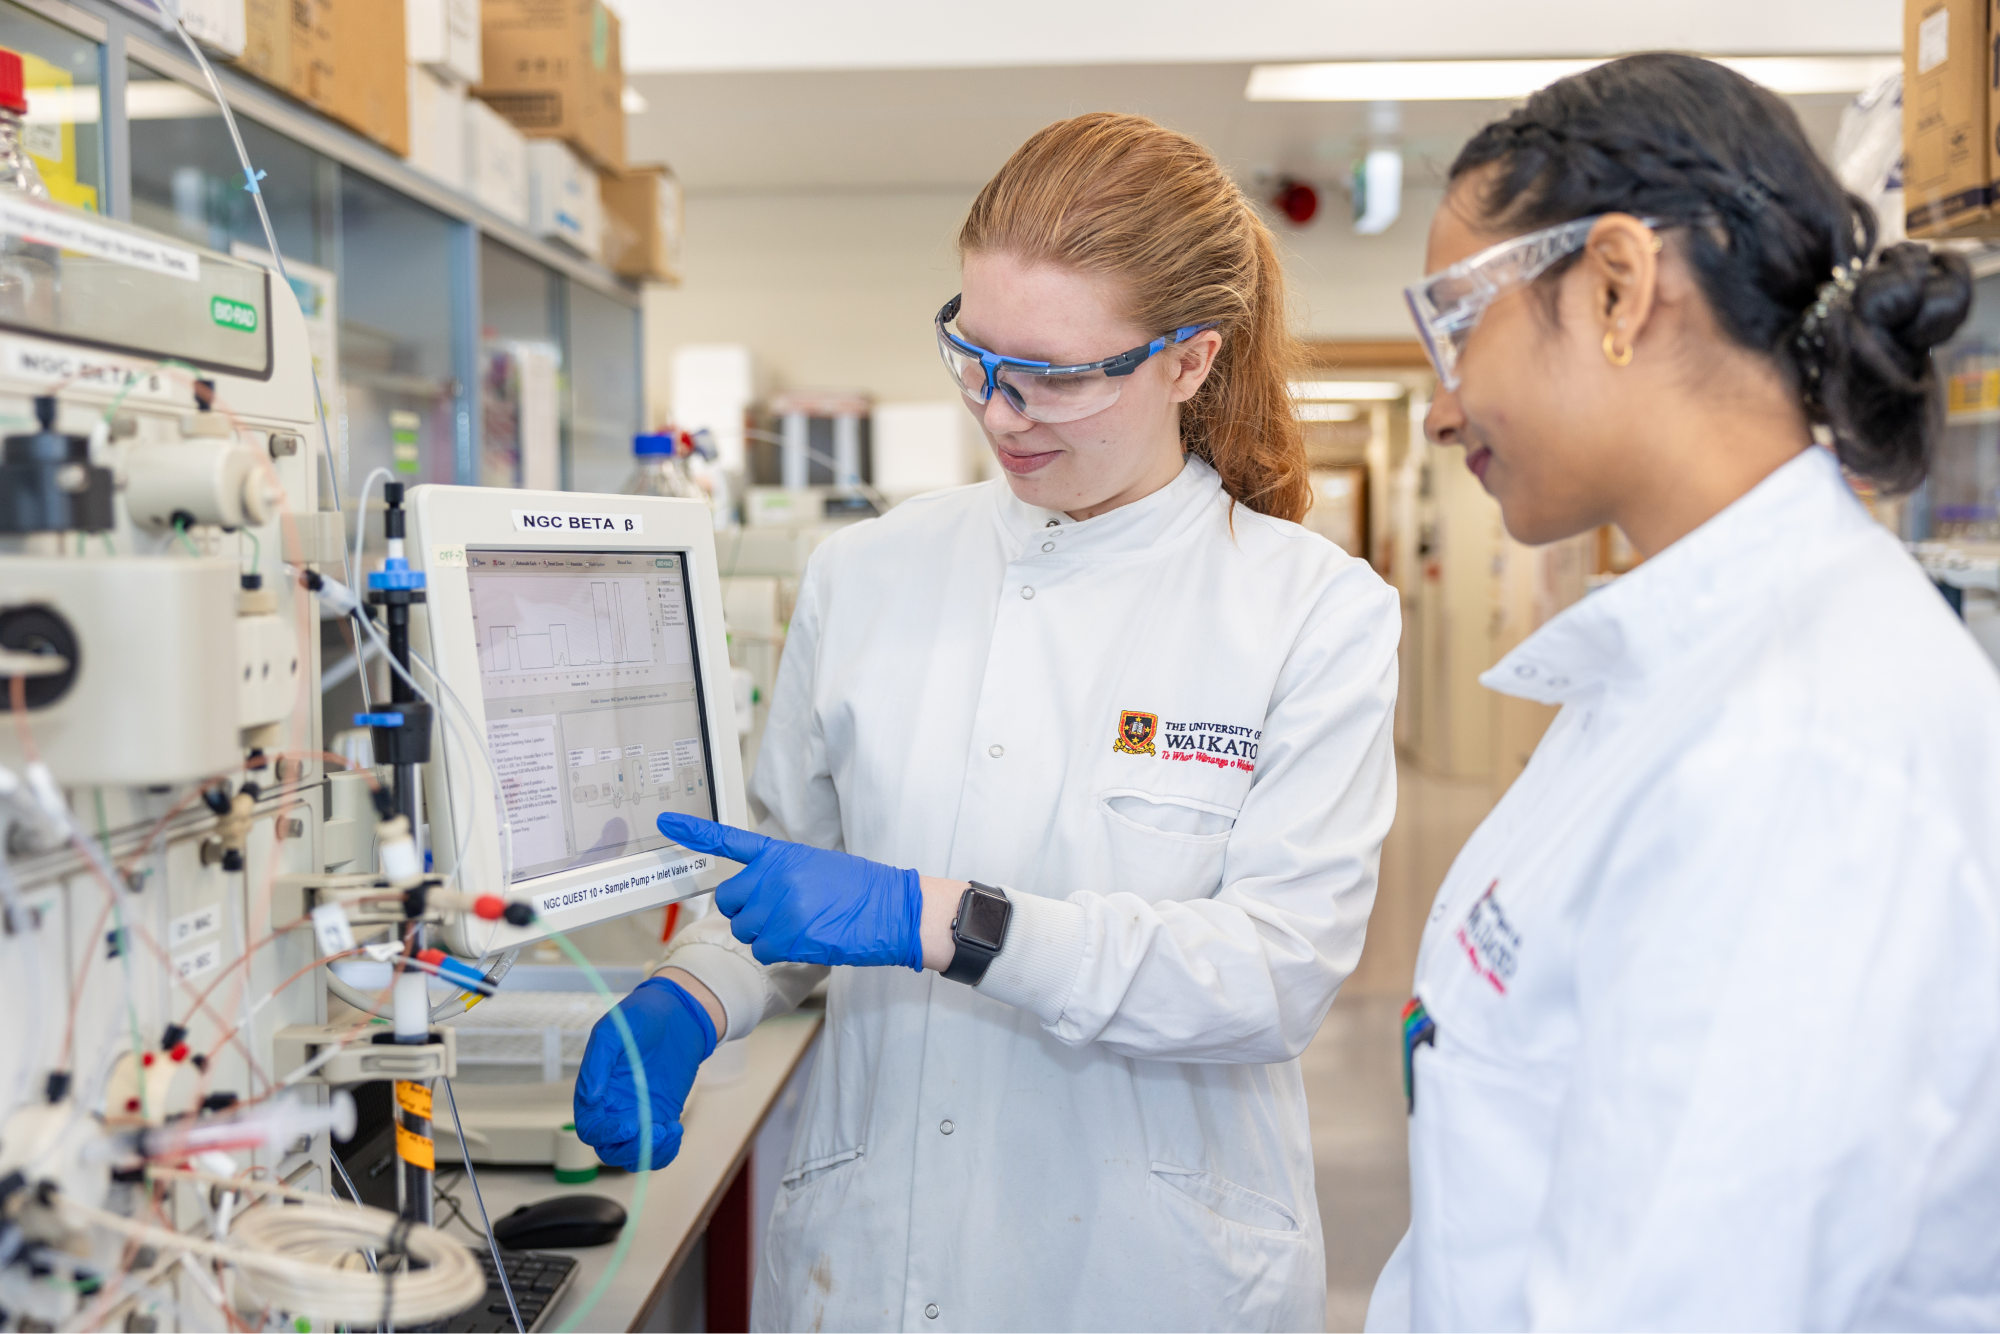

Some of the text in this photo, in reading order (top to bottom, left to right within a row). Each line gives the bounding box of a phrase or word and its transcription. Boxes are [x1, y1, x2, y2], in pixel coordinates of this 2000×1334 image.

[214, 301, 255, 327] BIO-RAD
[523, 515, 634, 532] NGC BETA β
[440, 550, 454, 561] OFF
[1166, 722, 1186, 732] THE
[1189, 722, 1253, 738] UNIVERSITY
[1161, 750, 1170, 760] Te
[1165, 734, 1258, 760] WAIKATO
[543, 897, 561, 910] NGC
[562, 890, 588, 906] QUEST
[590, 888, 598, 898] 10
[605, 880, 630, 894] Sample
[630, 874, 650, 888] Pump
[656, 868, 671, 881] Inlet
[671, 863, 689, 876] Valve
[694, 858, 707, 870] CSV
